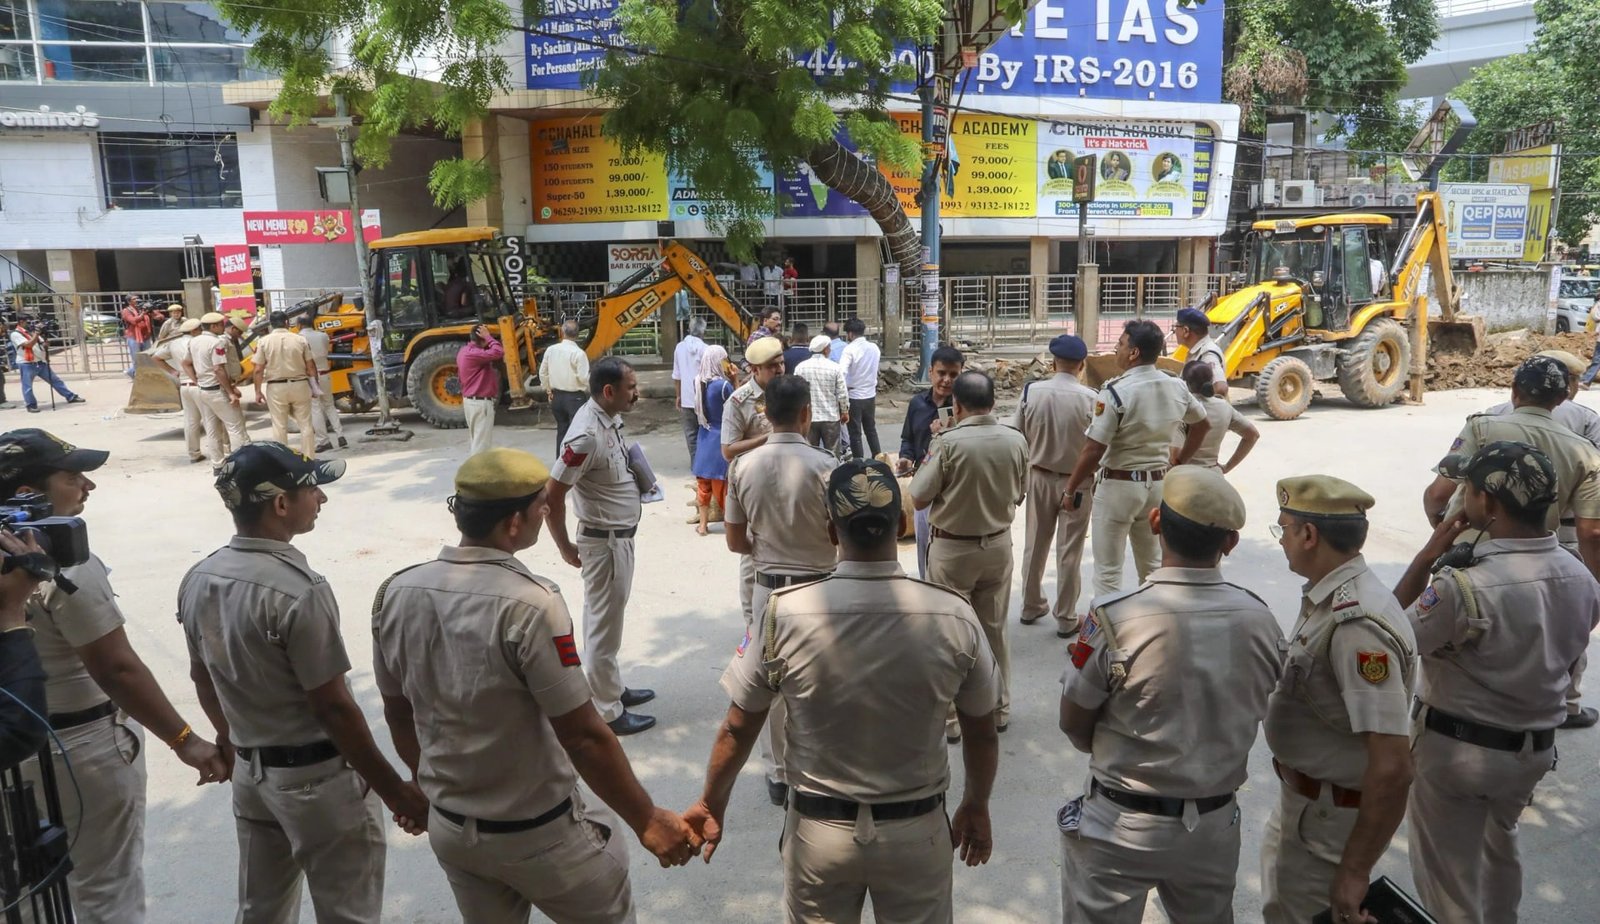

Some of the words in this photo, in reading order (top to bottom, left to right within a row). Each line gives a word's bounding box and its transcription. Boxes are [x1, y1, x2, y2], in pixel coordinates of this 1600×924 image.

[551, 20, 574, 34] Mains
[1096, 0, 1199, 45] IAS
[531, 43, 541, 59] By
[543, 39, 572, 56] Sachin
[531, 63, 545, 76] For
[546, 59, 595, 74] Personalized
[977, 52, 1023, 90] By
[1034, 54, 1199, 89] IRS-2016
[0, 104, 99, 127] omino's
[548, 124, 595, 141] CHAHAL
[963, 121, 1029, 136] ACADEMY
[572, 146, 590, 154] SIZE
[1087, 139, 1099, 147] It's
[1108, 138, 1146, 149] Hat-trick
[543, 163, 559, 172] 150
[543, 178, 559, 186] 100
[560, 178, 594, 186] STUDENTS
[546, 191, 585, 202] Super-50
[553, 207, 602, 217] 96259-21993
[609, 204, 662, 214] 93132-18122
[970, 201, 1030, 210] 93132-18122
[1463, 206, 1493, 221] QEP
[1497, 207, 1525, 218] SAW
[247, 220, 264, 231] NEW
[265, 219, 288, 231] MENU
[220, 253, 246, 265] NEW
[221, 263, 247, 274] MENU
[1402, 263, 1421, 301] JCB
[618, 289, 662, 327] JCB
[1274, 302, 1288, 313] JCB
[317, 320, 342, 330] JCB
